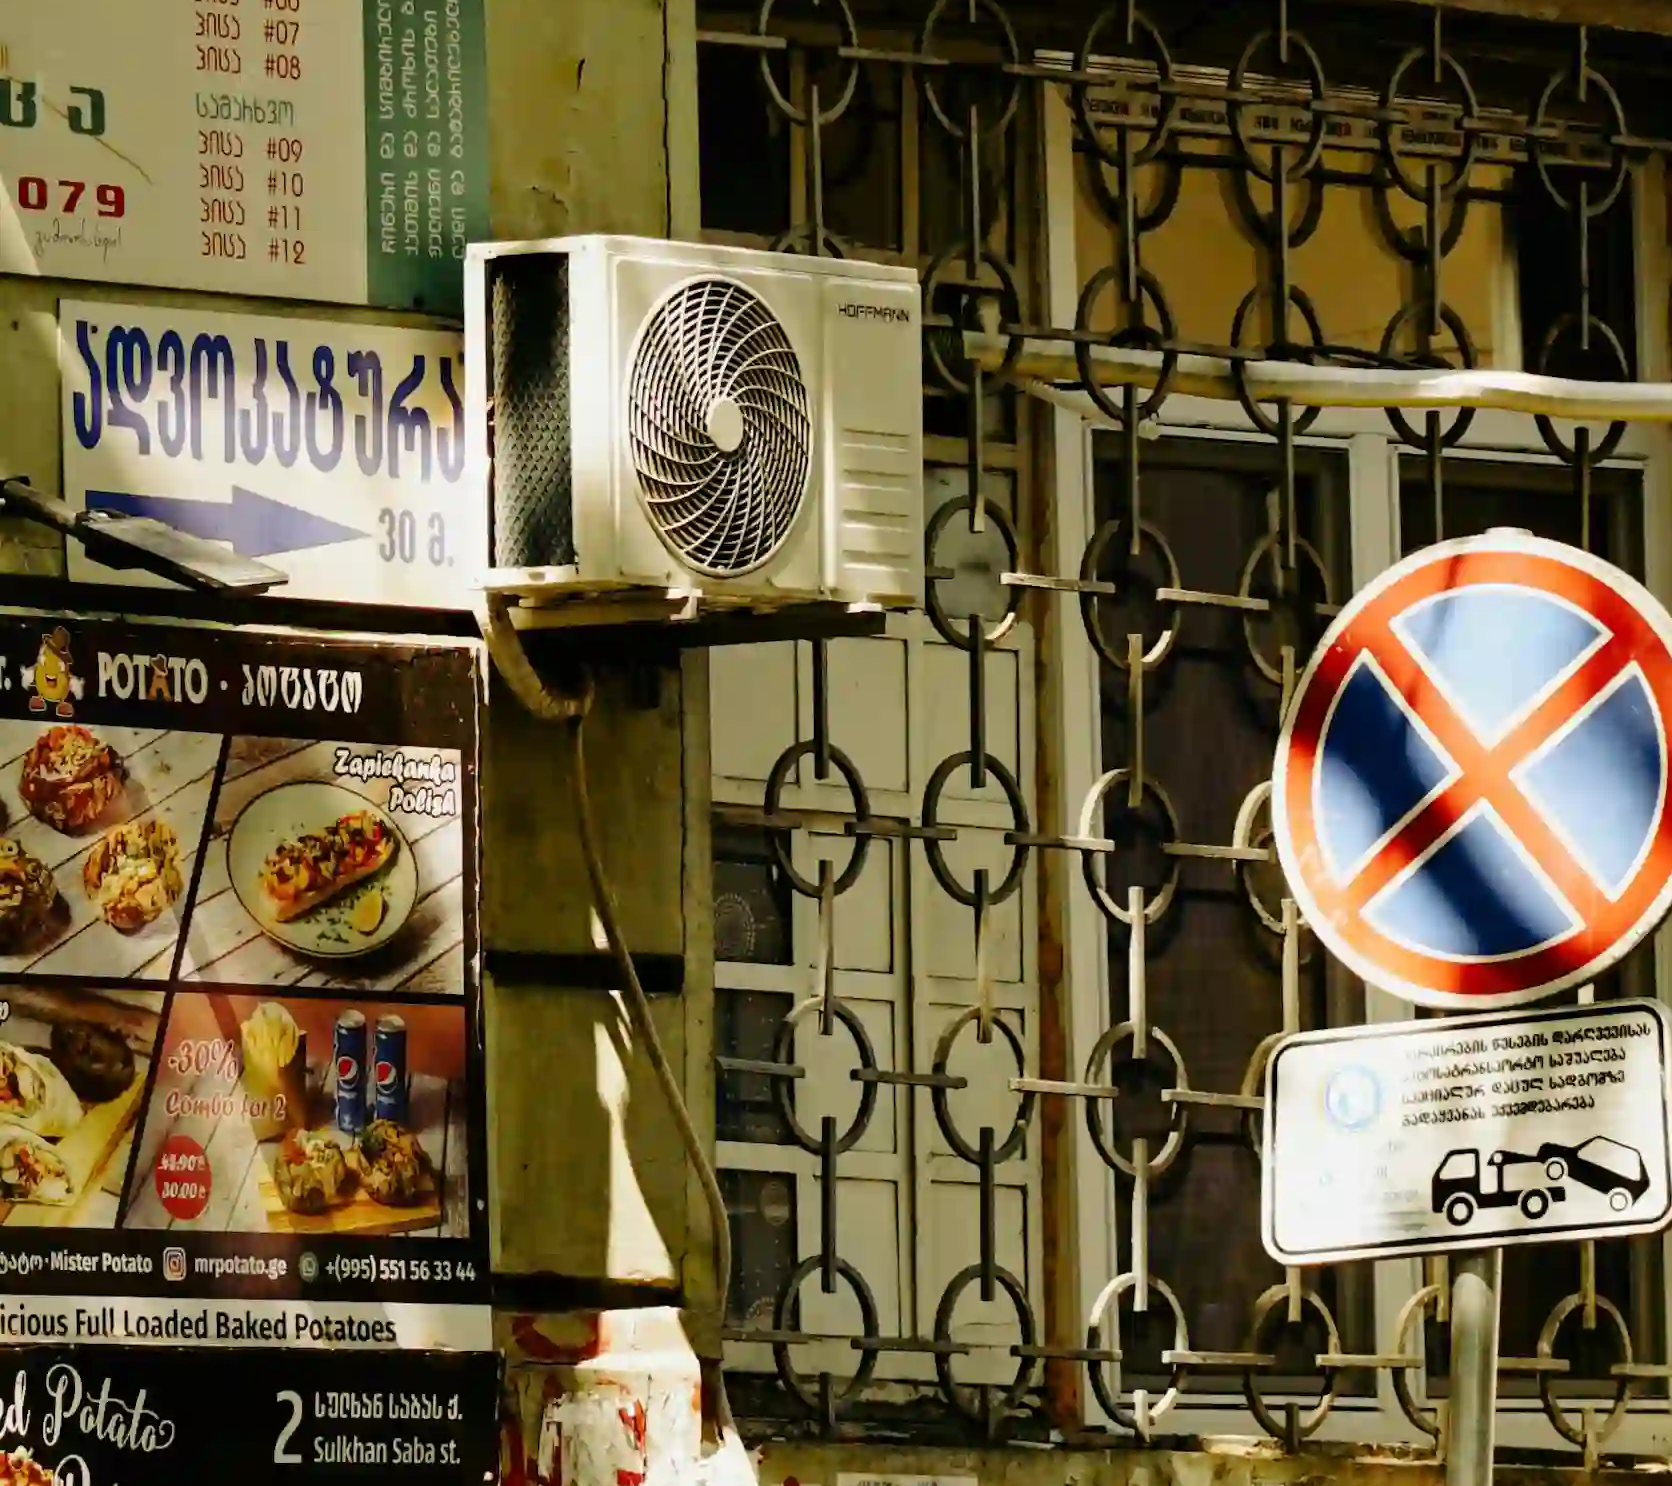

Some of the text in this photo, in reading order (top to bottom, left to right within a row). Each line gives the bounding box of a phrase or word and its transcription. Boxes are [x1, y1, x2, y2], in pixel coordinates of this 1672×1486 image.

[195, 10, 300, 47] პიცა #07
[196, 44, 301, 81] პიცა #08
[195, 91, 296, 127] სამარხვო
[198, 129, 304, 163] პიცა #09
[200, 163, 304, 198] პიცა #10
[200, 197, 302, 231] პიცა #11
[201, 231, 307, 266] პიცა #12
[837, 302, 910, 324] HOFFMANN
[73, 319, 465, 484] ადვოკატურა
[378, 506, 417, 563] 30
[97, 651, 209, 705] POTATO
[102, 1252, 153, 1274] Potato
[194, 1255, 288, 1281] mrpotato.ge
[325, 1254, 477, 1283] +(995) 551 56 33 44
[75, 1306, 115, 1337] Full
[123, 1309, 208, 1340] Loaded
[216, 1310, 288, 1340] Baked
[295, 1312, 398, 1343] Potatoes
[43, 1363, 176, 1453] Potato
[314, 1391, 384, 1420] სულხან
[388, 1393, 443, 1421] საბას
[273, 1389, 304, 1466] 2
[313, 1435, 462, 1466] Sulkhan Saba st.
